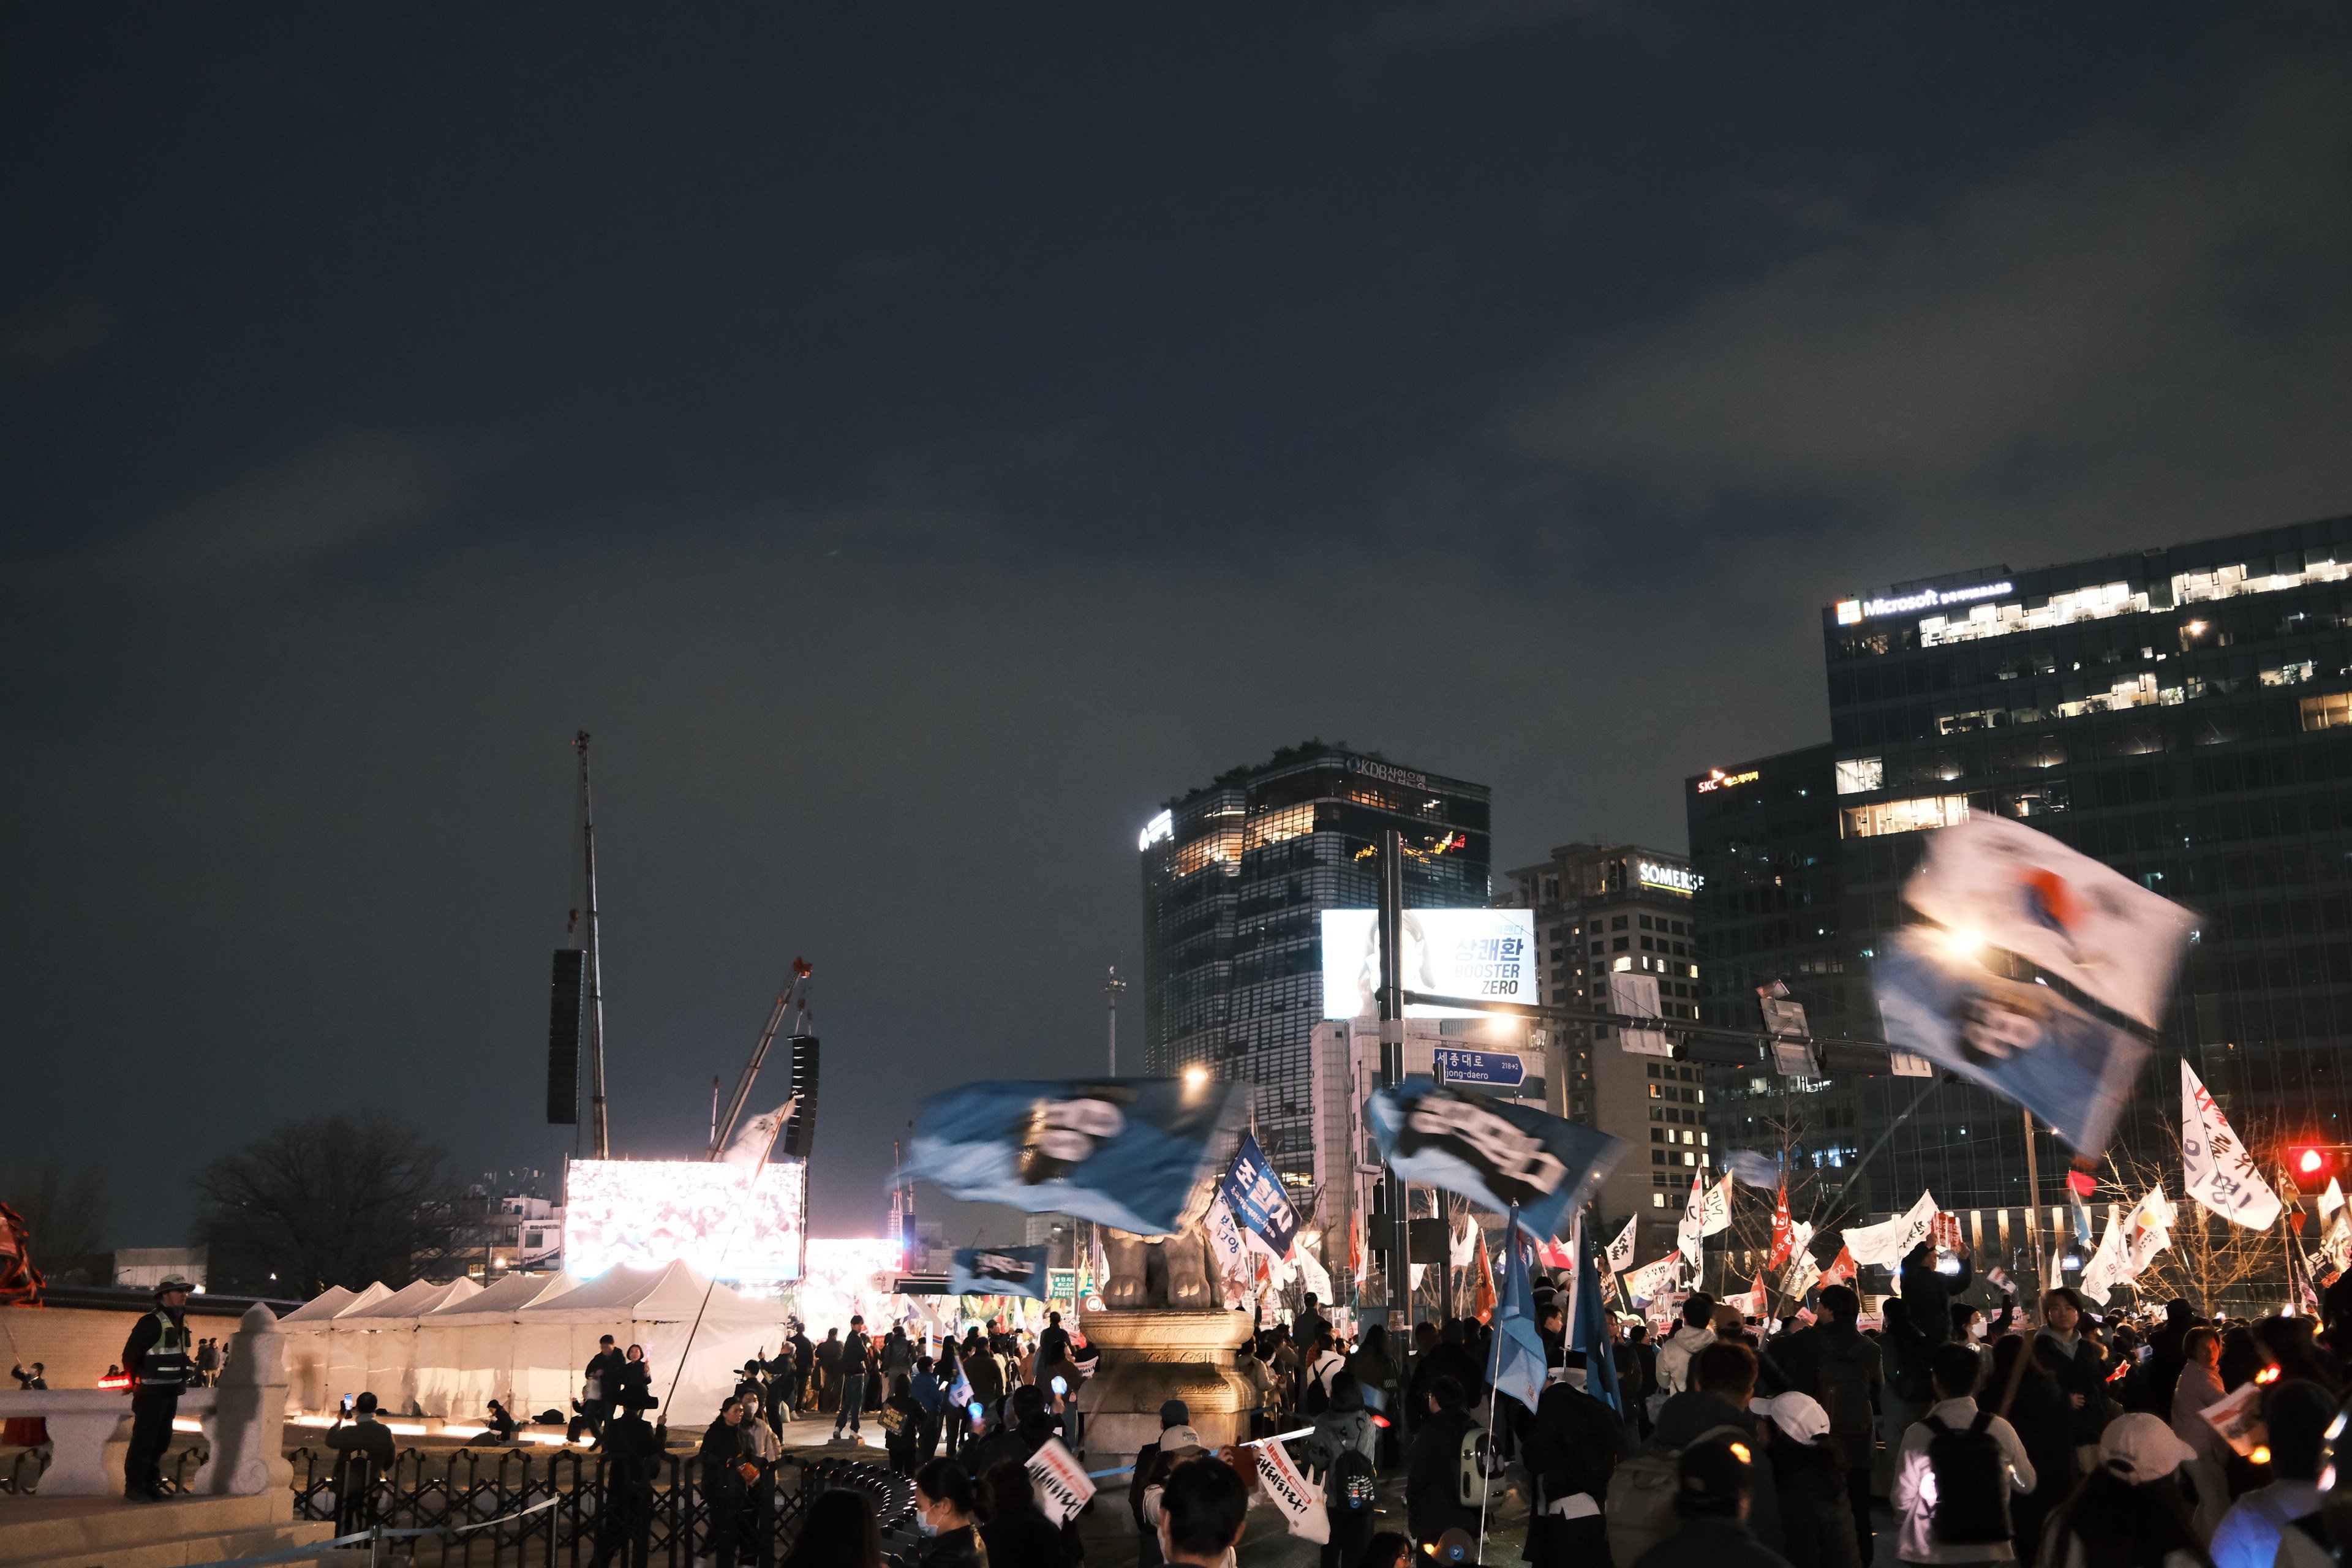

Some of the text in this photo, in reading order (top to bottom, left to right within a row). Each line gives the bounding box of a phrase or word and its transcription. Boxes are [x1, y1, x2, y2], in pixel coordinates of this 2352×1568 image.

[1863, 589, 1938, 616] Microsoft
[1361, 759, 1427, 791] KDB산업은행
[1698, 779, 1718, 793] SKC
[1455, 937, 1524, 961] 상쾌환
[1455, 963, 1520, 978] BOOSTER
[1481, 980, 1518, 995] ZERO
[1437, 1051, 1484, 1068] 세종대로
[1445, 1068, 1489, 1080] jong-daero
[1266, 1442, 1290, 1477] 내란동조
[1256, 1454, 1308, 1515] 해체하라!
